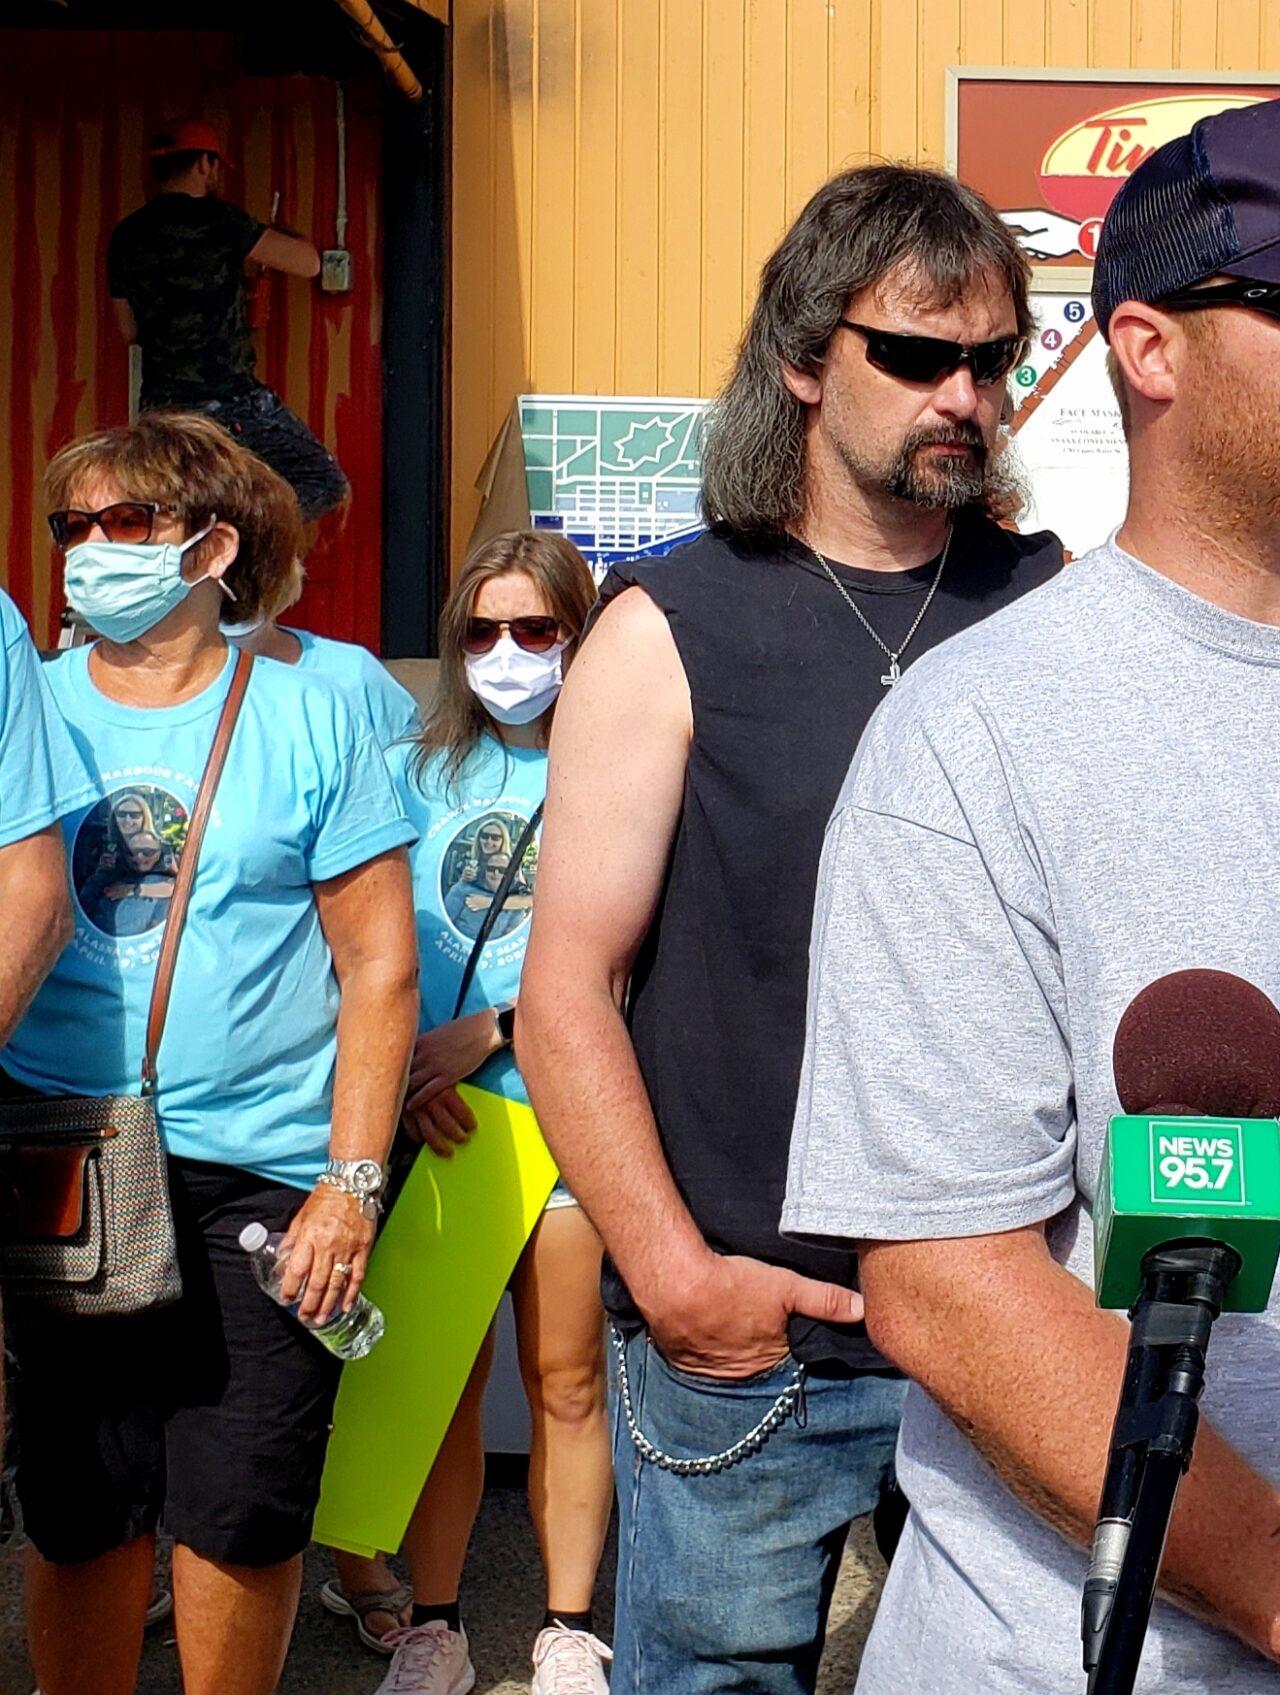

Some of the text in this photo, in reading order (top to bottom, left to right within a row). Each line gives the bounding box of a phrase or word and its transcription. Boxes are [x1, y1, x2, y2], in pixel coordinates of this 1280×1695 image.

[1069, 303, 1080, 320] 5
[1044, 331, 1057, 348] 4
[1020, 368, 1032, 384] 3
[1159, 1136, 1234, 1158] NEWS
[1159, 1156, 1234, 1190] 95.7
